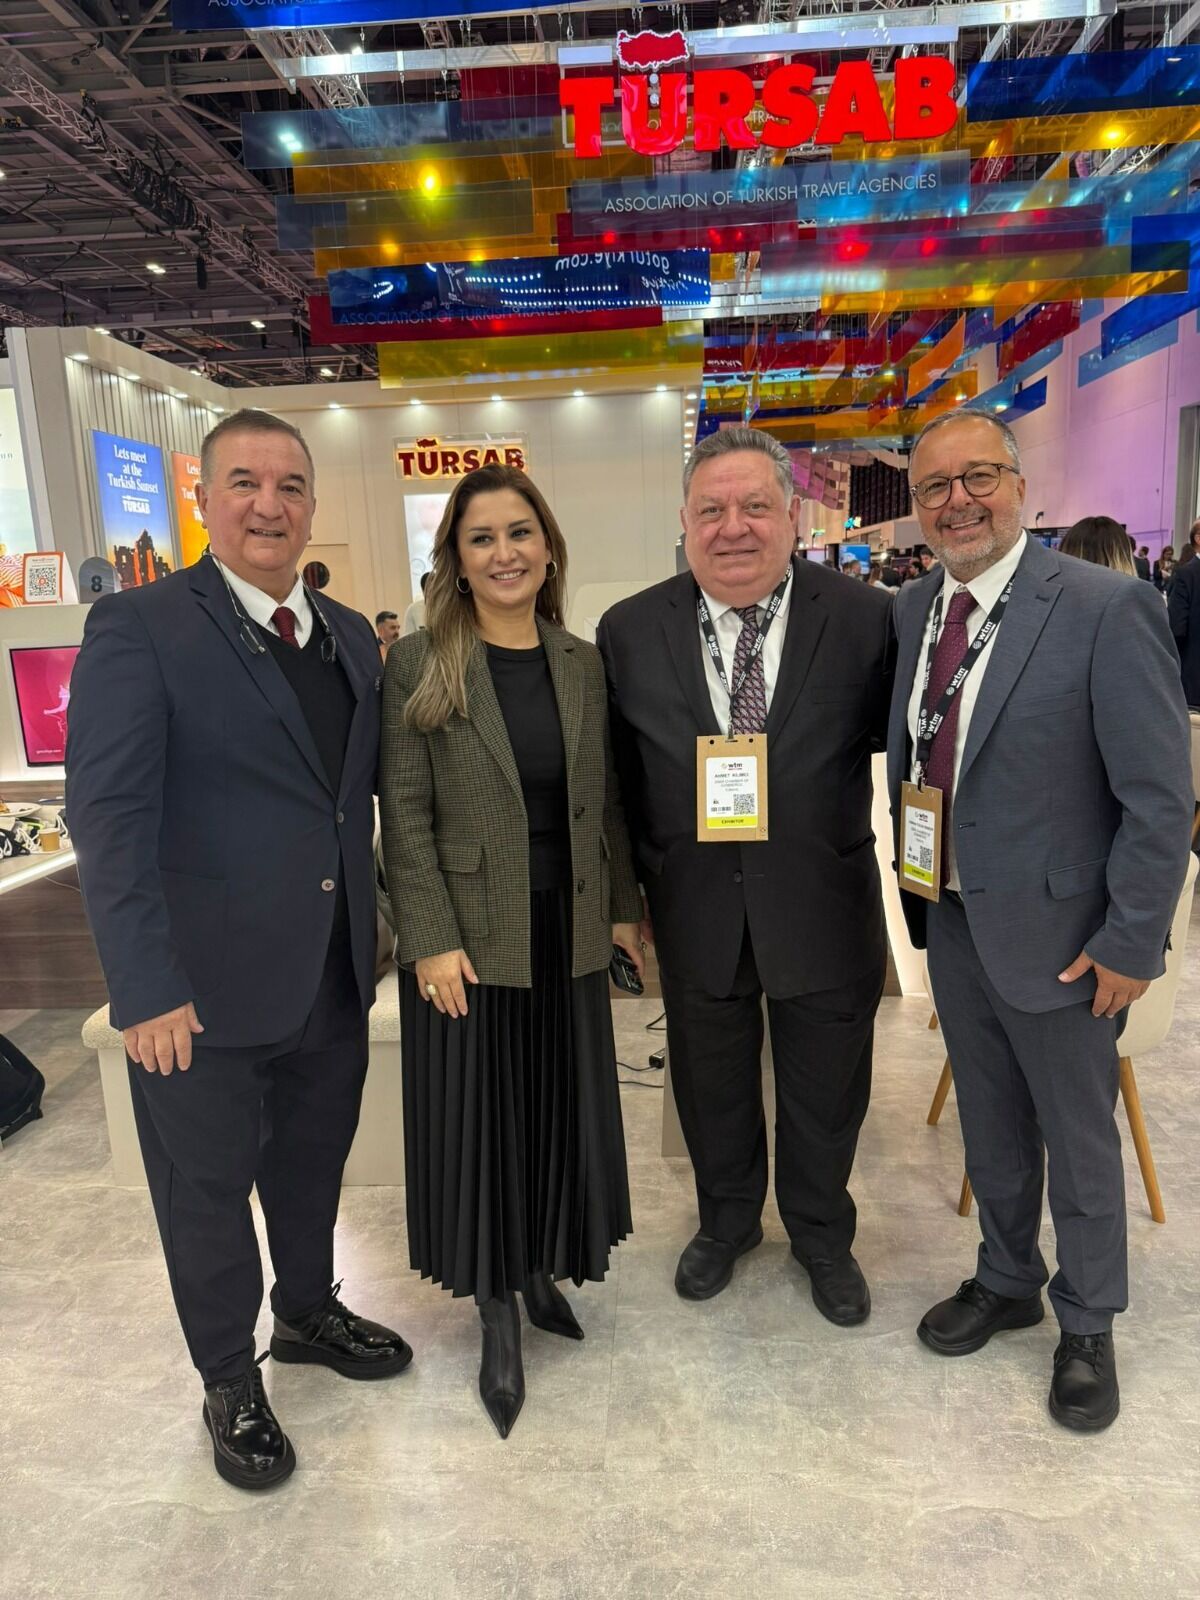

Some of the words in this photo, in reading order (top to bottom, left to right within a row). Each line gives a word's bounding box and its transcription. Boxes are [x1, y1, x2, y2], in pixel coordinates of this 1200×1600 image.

[604, 193, 708, 213] ASSOCIATION
[712, 190, 733, 206] OF
[739, 185, 798, 204] TURKISH
[802, 180, 854, 199] TRAVEL
[858, 173, 937, 194] AGENCIES
[107, 472, 137, 490] Turkish
[91, 575, 103, 593] 8
[978, 619, 993, 642] wtm
[951, 667, 966, 688] wtm
[928, 712, 941, 734] wtm
